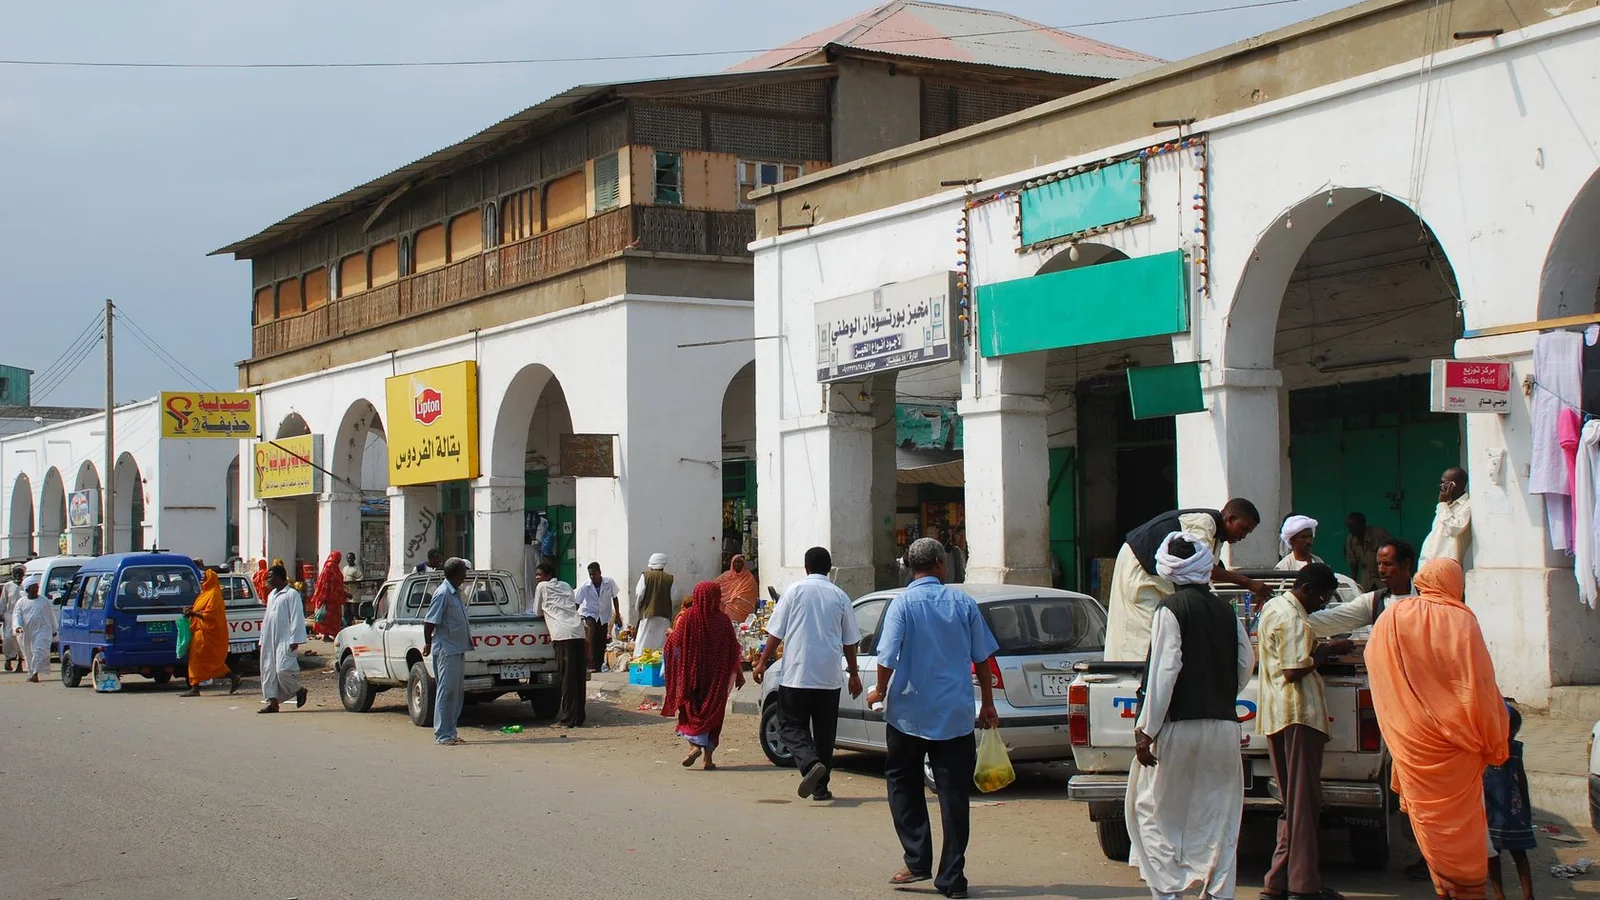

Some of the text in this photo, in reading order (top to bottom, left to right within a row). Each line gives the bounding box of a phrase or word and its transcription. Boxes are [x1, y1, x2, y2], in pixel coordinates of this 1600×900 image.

[831, 301, 929, 346] مخبز بورتسودان الوطني
[1463, 376, 1480, 384] Sales
[198, 394, 251, 416] صيدلية
[416, 398, 441, 418] Lipton
[191, 415, 251, 437] حذيفة 2
[395, 434, 461, 470] بقالة الفردوس
[405, 505, 436, 559] الفردوس
[228, 619, 263, 633] YOT
[471, 633, 552, 648] TOYOT
[1343, 816, 1380, 829] TOYOTA
